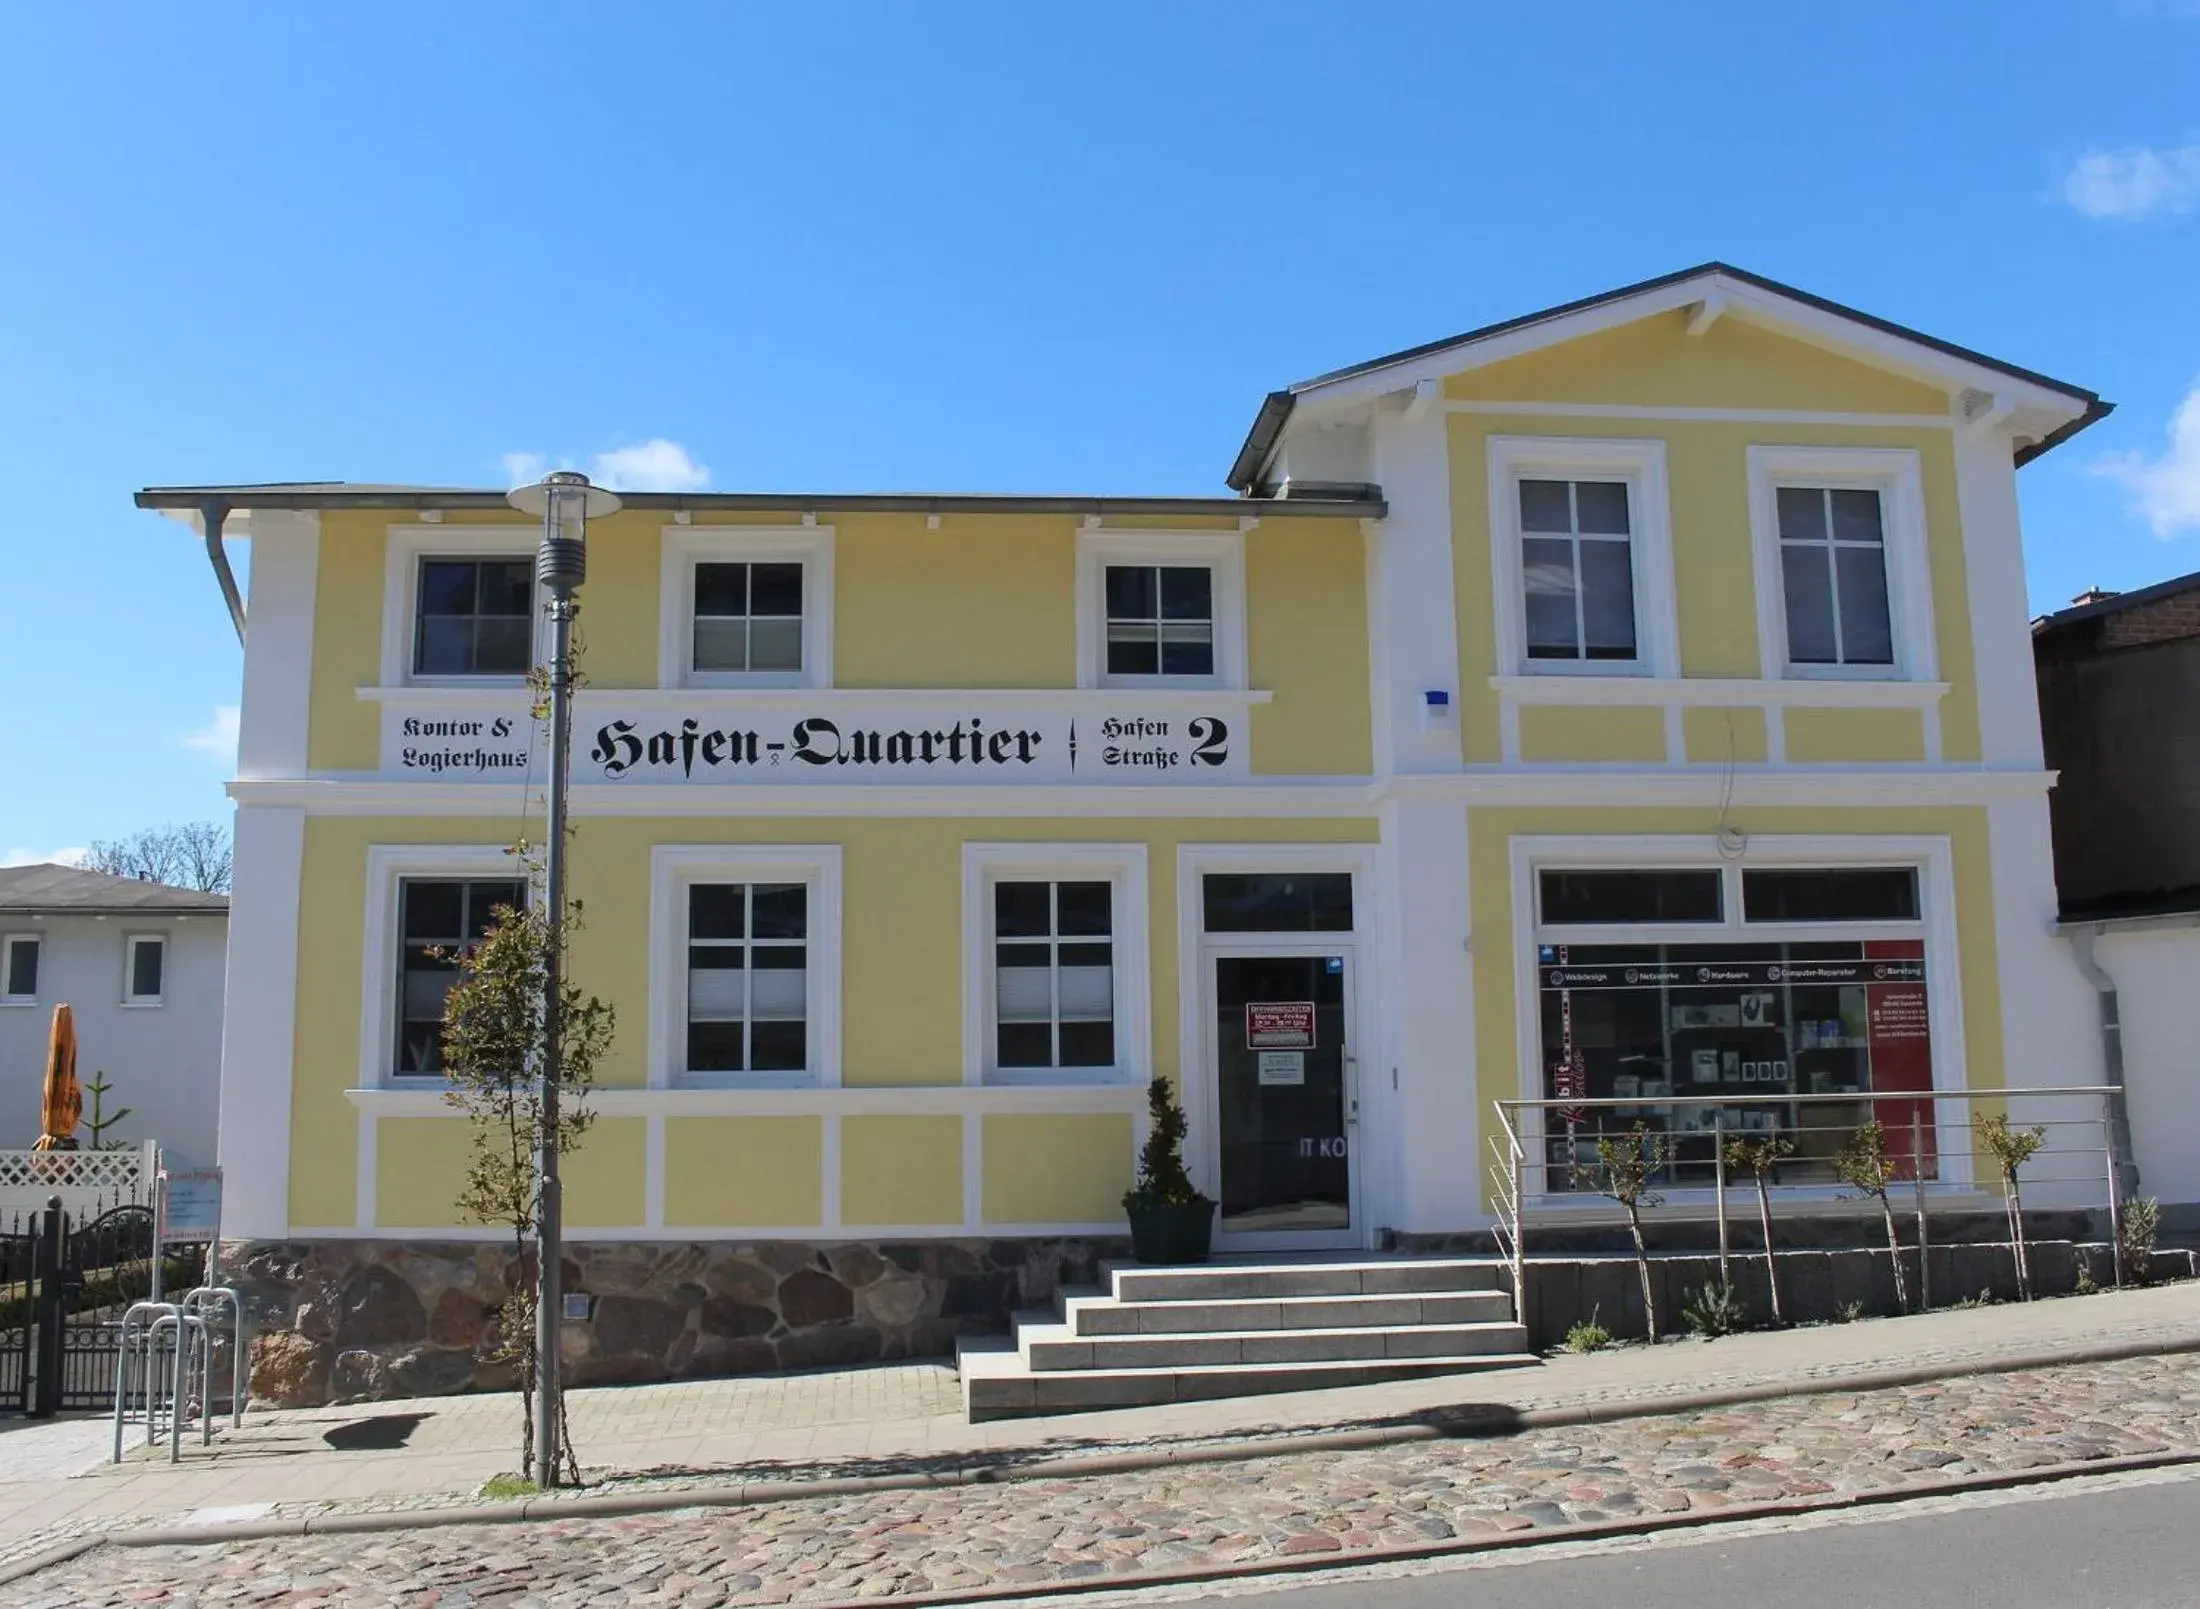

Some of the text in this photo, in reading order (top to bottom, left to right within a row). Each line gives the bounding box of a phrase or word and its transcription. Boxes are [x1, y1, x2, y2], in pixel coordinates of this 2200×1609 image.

[403, 717, 513, 738] Kontor &
[1101, 717, 1169, 741] Hafen
[591, 717, 1043, 781] Hafen-Quartier
[1188, 716, 1229, 767] 2
[402, 747, 528, 773] Logierhaus
[1102, 746, 1180, 770] Straße
[1564, 972, 1608, 983] Webdesign
[1711, 970, 1750, 980] Hardware
[1300, 1137, 1315, 1157] IT
